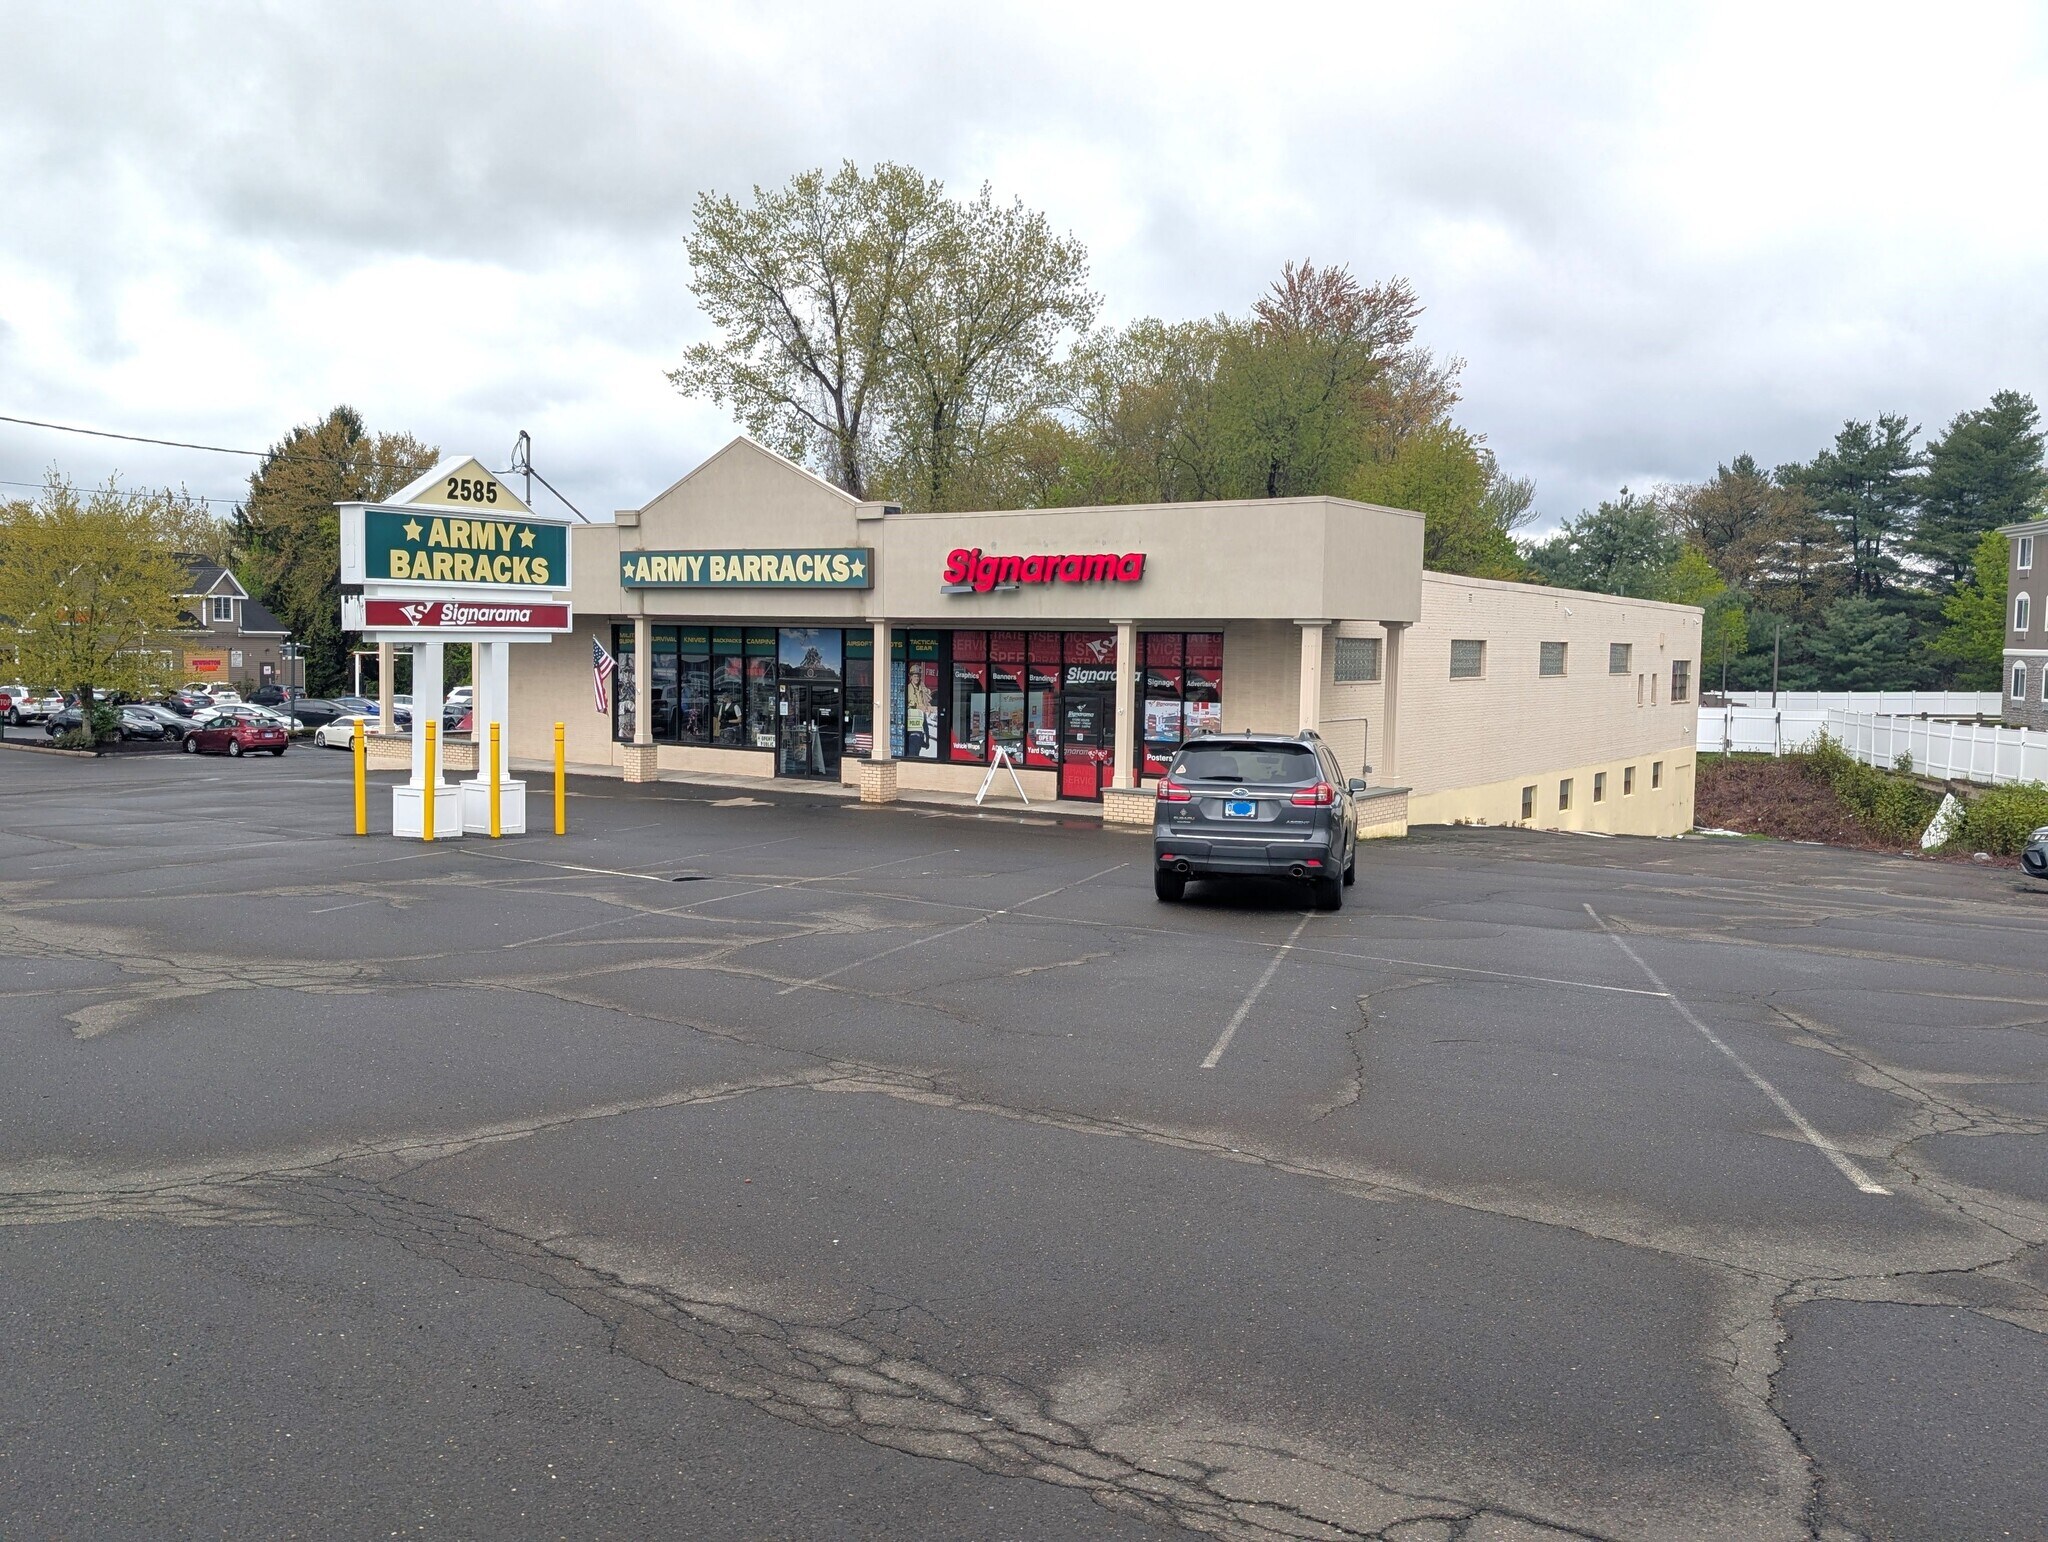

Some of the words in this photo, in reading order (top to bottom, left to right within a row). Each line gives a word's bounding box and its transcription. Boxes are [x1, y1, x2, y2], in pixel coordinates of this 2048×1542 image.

[446, 477, 497, 503] 2585
[428, 518, 516, 551] ARMY
[390, 549, 549, 584] BARRACKS
[635, 556, 704, 582] ARMY
[710, 554, 850, 582] BARRACKS
[944, 548, 1146, 593] Signarama
[440, 603, 532, 625] Signarama
[954, 671, 980, 679] Graphics
[1066, 667, 1142, 684] Signaraa
[1147, 678, 1175, 688] Signage
[1186, 680, 1217, 688] Advertising
[953, 742, 968, 750] Vehicle
[968, 743, 980, 751] Wraps
[1040, 748, 1055, 756] Signs
[1146, 753, 1173, 762] Posters
